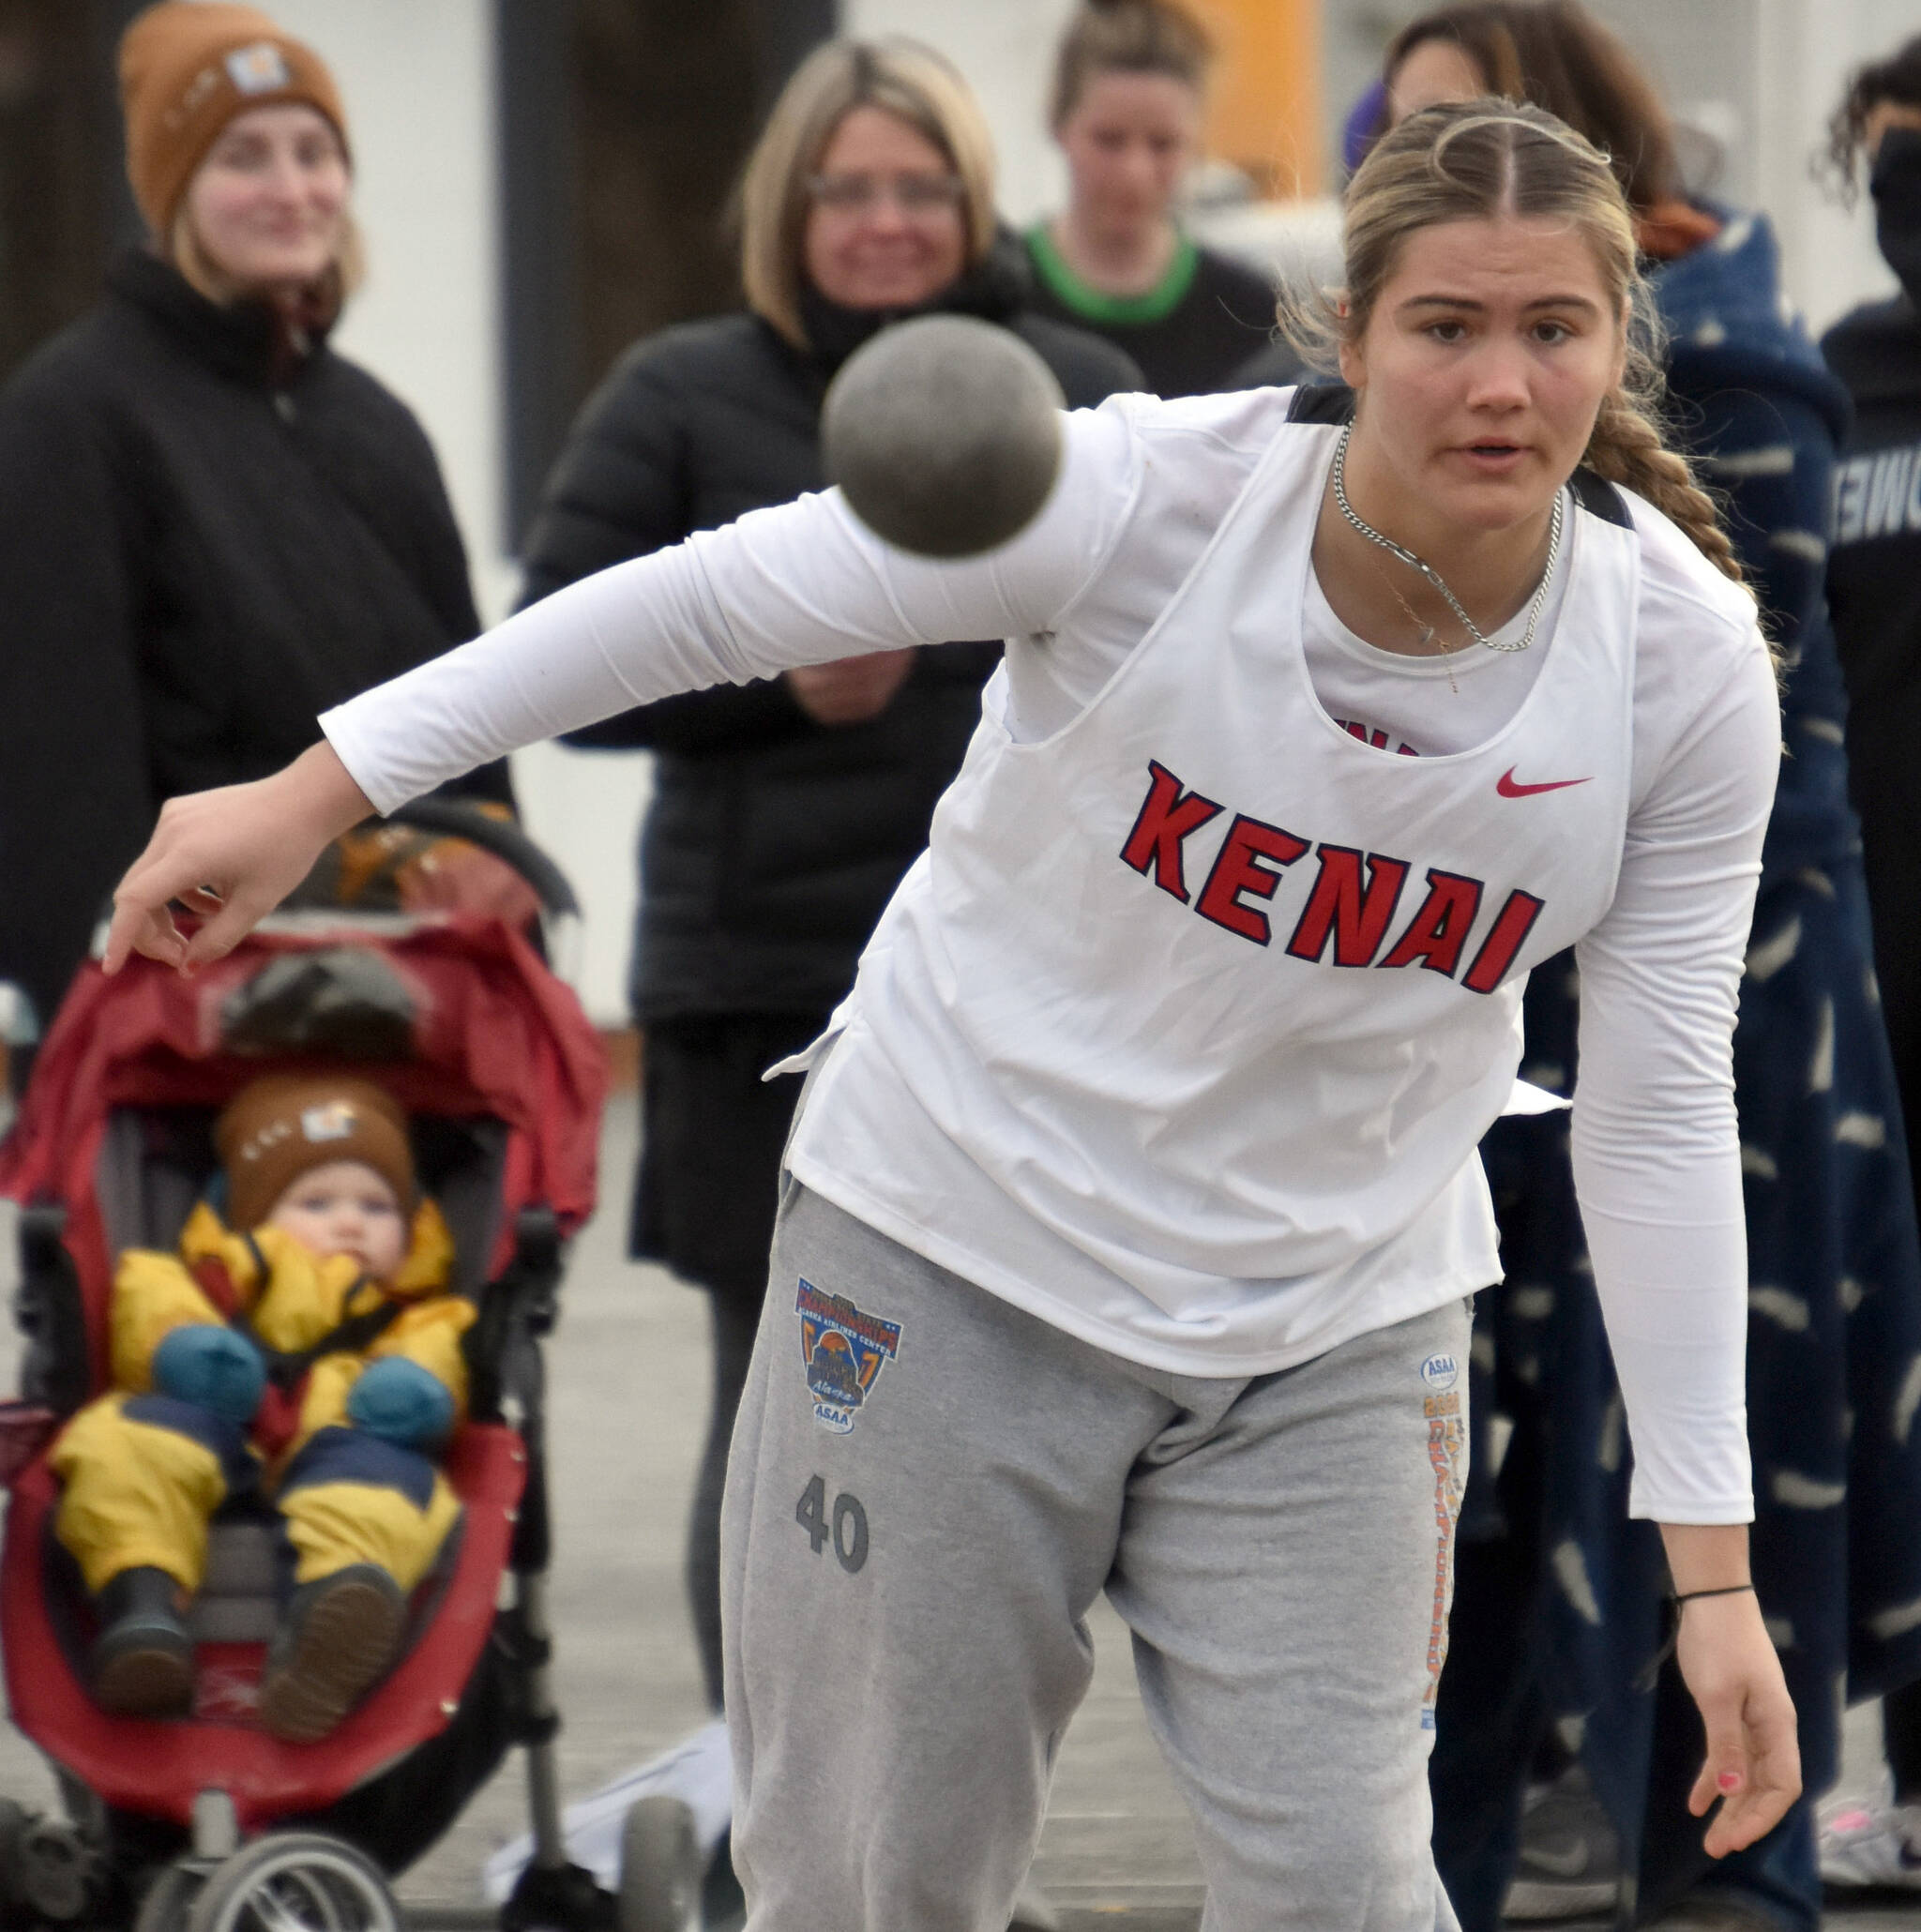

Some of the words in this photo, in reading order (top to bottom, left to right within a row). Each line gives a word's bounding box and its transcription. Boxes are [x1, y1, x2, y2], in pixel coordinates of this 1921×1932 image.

[1120, 759, 1546, 995] KENAI
[824, 1316, 857, 1338] AIRLINES
[859, 1335, 891, 1356] CENTER
[1429, 1358, 1455, 1376] ASAA
[815, 1405, 849, 1426] ASAA
[796, 1473, 869, 1575] 40
